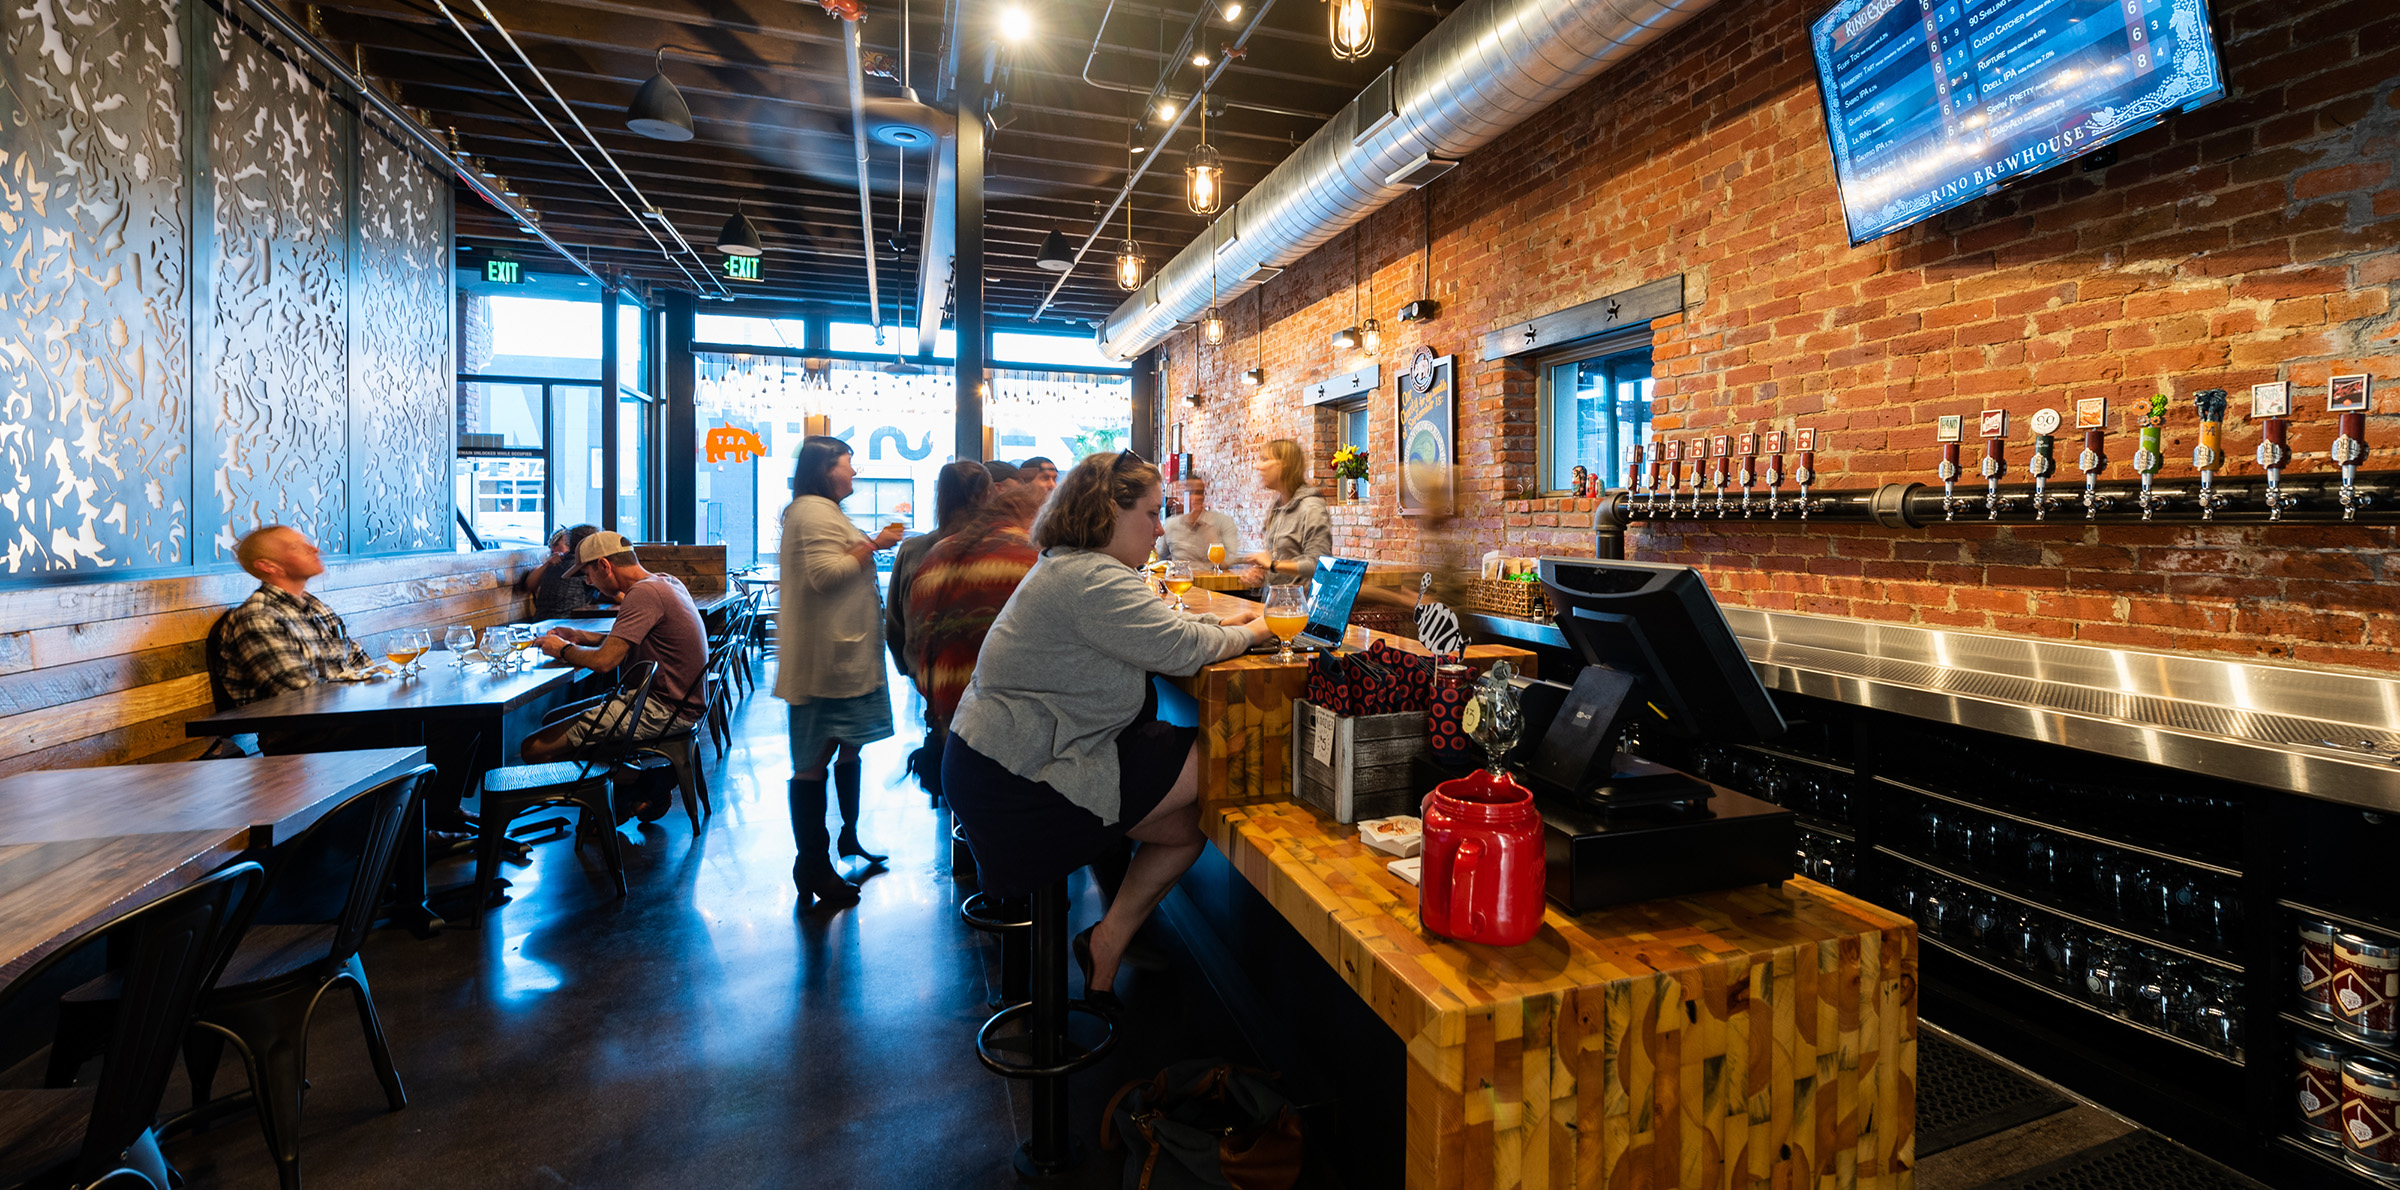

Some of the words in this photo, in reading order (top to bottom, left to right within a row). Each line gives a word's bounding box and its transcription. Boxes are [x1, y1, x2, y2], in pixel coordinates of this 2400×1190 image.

[1926, 20, 1933, 31] 6
[1938, 14, 1944, 23] 3
[1950, 6, 1955, 15] 9
[1968, 15, 1979, 27] 90
[1930, 41, 1938, 52] 6
[1942, 35, 1948, 44] 3
[1954, 28, 1960, 37] 9
[1973, 32, 1995, 49] CLOUD
[1995, 13, 2026, 35] CATCHER
[1977, 50, 2007, 72] RUPTURE
[2127, 0, 2137, 14] 6
[1935, 62, 1942, 73] 6
[1946, 57, 1952, 65] 3
[1958, 49, 1964, 58] 9
[1982, 78, 2003, 93] ODELL
[2003, 68, 2017, 82] IPA
[2132, 27, 2142, 41] 6
[2151, 19, 2159, 30] 3
[1939, 83, 1946, 95] 6
[1951, 78, 1957, 87] 3
[1962, 71, 1968, 80] 9
[2008, 85, 2035, 104] PRETTY
[2137, 54, 2147, 68] 8
[2156, 46, 2164, 57] 4
[1943, 104, 1950, 116] 6
[1955, 100, 1961, 108] 3
[1967, 93, 1973, 101] 9
[1948, 125, 1955, 136] 6
[1931, 176, 1968, 204] RINO
[1973, 125, 2086, 186] BREWHOUSE
[488, 260, 519, 282] EXIT
[729, 255, 760, 279] EXIT
[2036, 415, 2056, 426] 90
